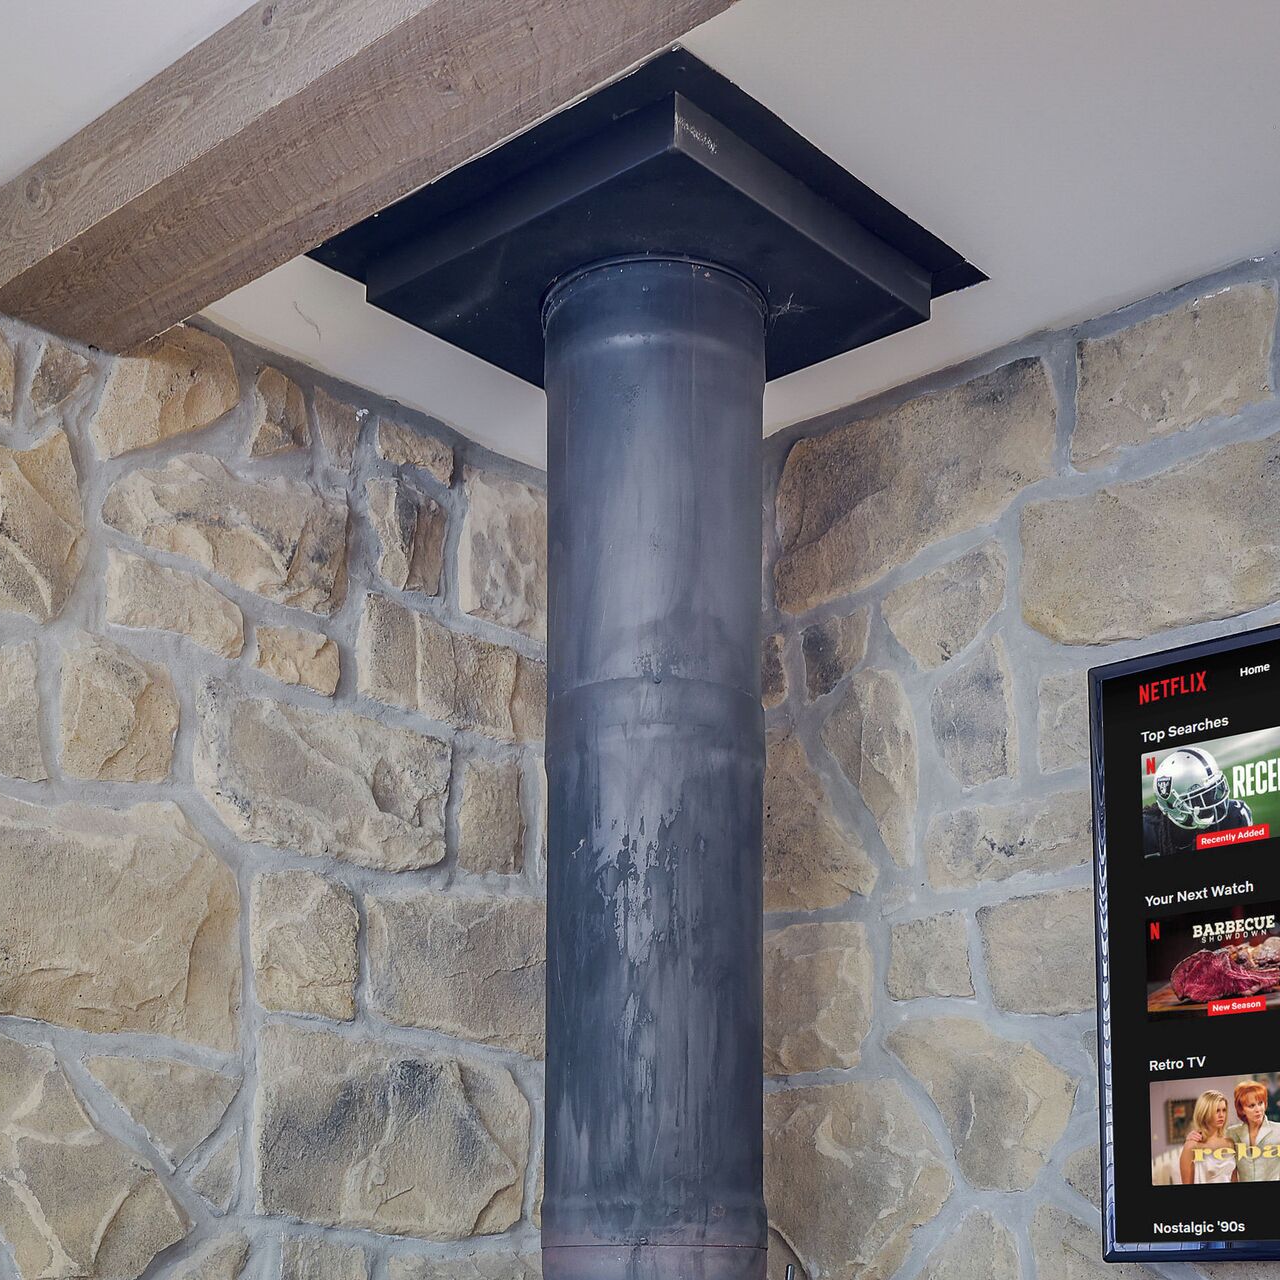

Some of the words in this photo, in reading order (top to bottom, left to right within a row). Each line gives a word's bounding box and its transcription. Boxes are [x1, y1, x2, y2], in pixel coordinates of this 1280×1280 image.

[1240, 662, 1271, 677] Home
[1139, 670, 1207, 705] NETFLIX
[1141, 730, 1165, 743] Top
[1168, 716, 1230, 738] Searches
[1201, 832, 1236, 846] Recently
[1237, 828, 1265, 840] Added
[1145, 891, 1175, 907] Your
[1177, 887, 1209, 902] Next
[1211, 880, 1254, 899] Watch
[1192, 914, 1276, 940] BARBECUE
[1200, 928, 1269, 944] SHOWDOWN
[1212, 1003, 1231, 1014] New
[1231, 999, 1262, 1012] Season
[1149, 1056, 1184, 1073] Retro
[1186, 1055, 1207, 1069] TV
[1153, 1221, 1214, 1236] Nostalgic
[1217, 1220, 1246, 1233] '90s
